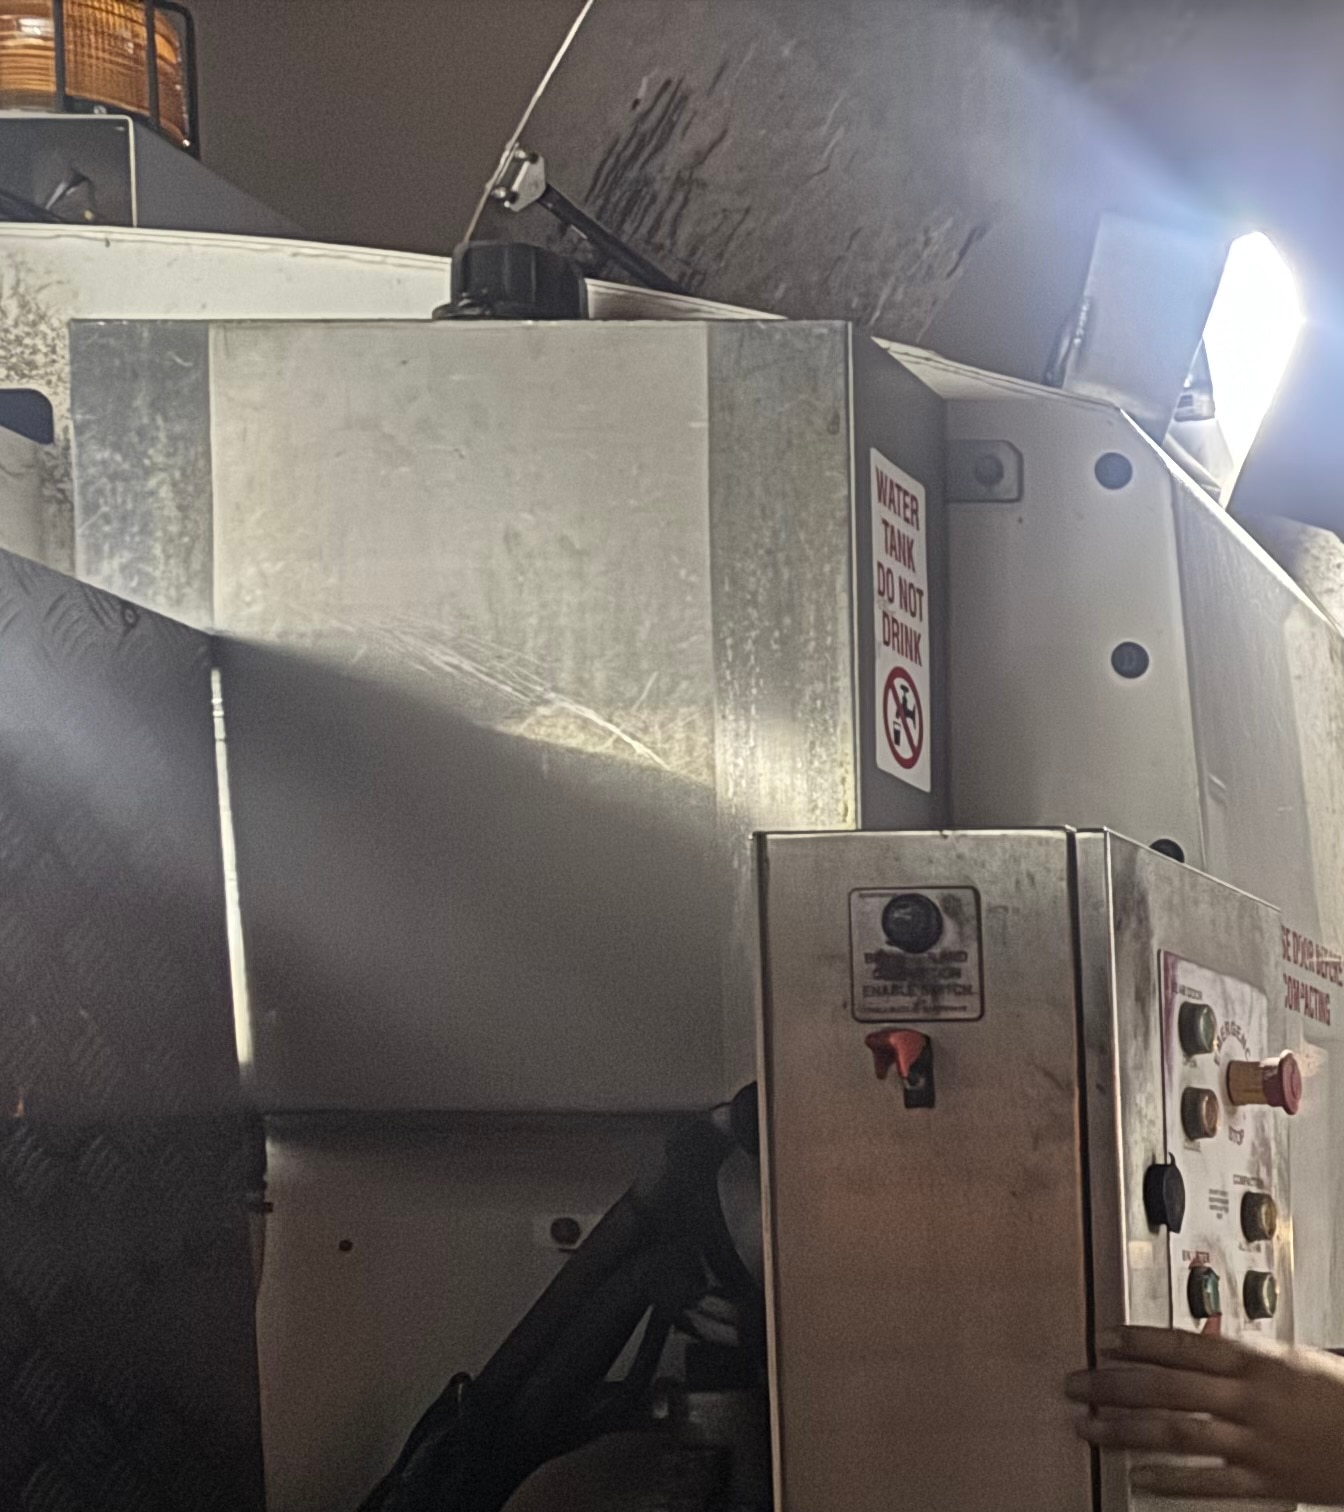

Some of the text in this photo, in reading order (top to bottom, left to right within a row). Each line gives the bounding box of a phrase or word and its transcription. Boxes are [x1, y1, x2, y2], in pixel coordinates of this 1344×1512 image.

[875, 466, 920, 531] WATER
[882, 519, 916, 573] TANK
[877, 560, 924, 623] DO NOT
[882, 610, 922, 666] DRINK
